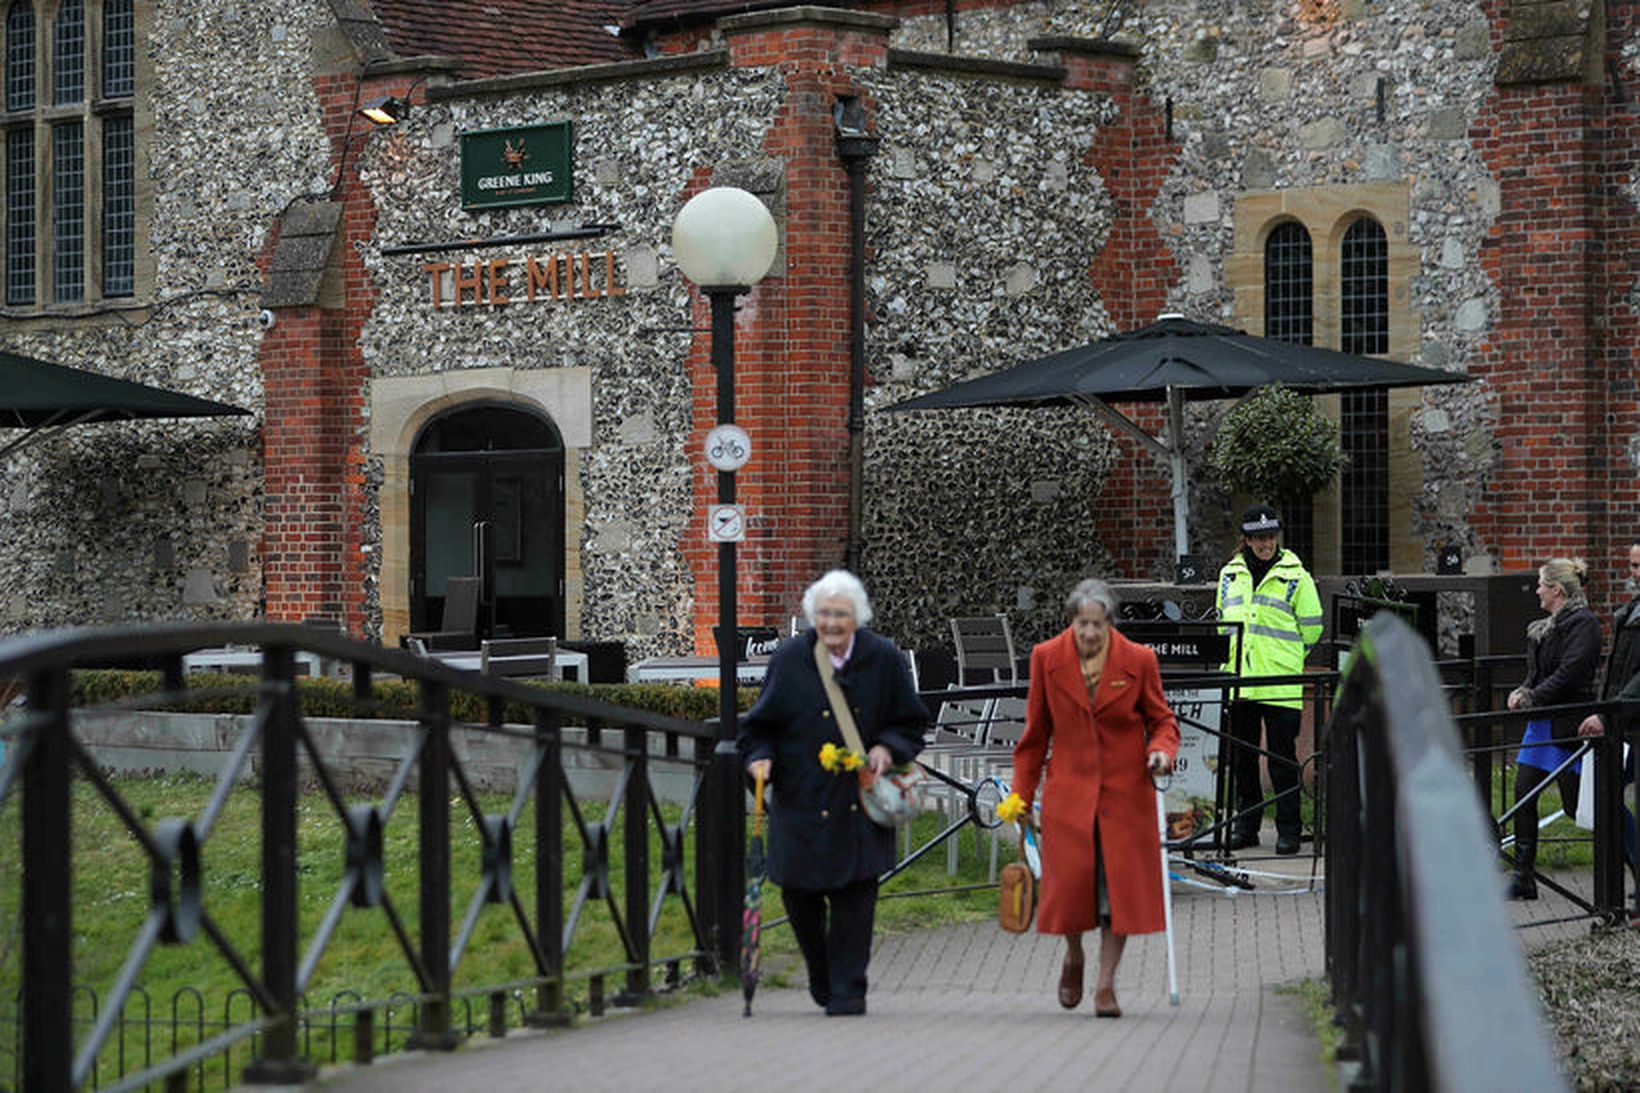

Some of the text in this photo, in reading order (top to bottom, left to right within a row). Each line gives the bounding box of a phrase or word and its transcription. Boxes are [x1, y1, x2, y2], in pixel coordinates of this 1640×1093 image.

[477, 171, 553, 190] GREENE KING
[422, 250, 626, 310] THE MILL
[1171, 644, 1199, 655] MILL
